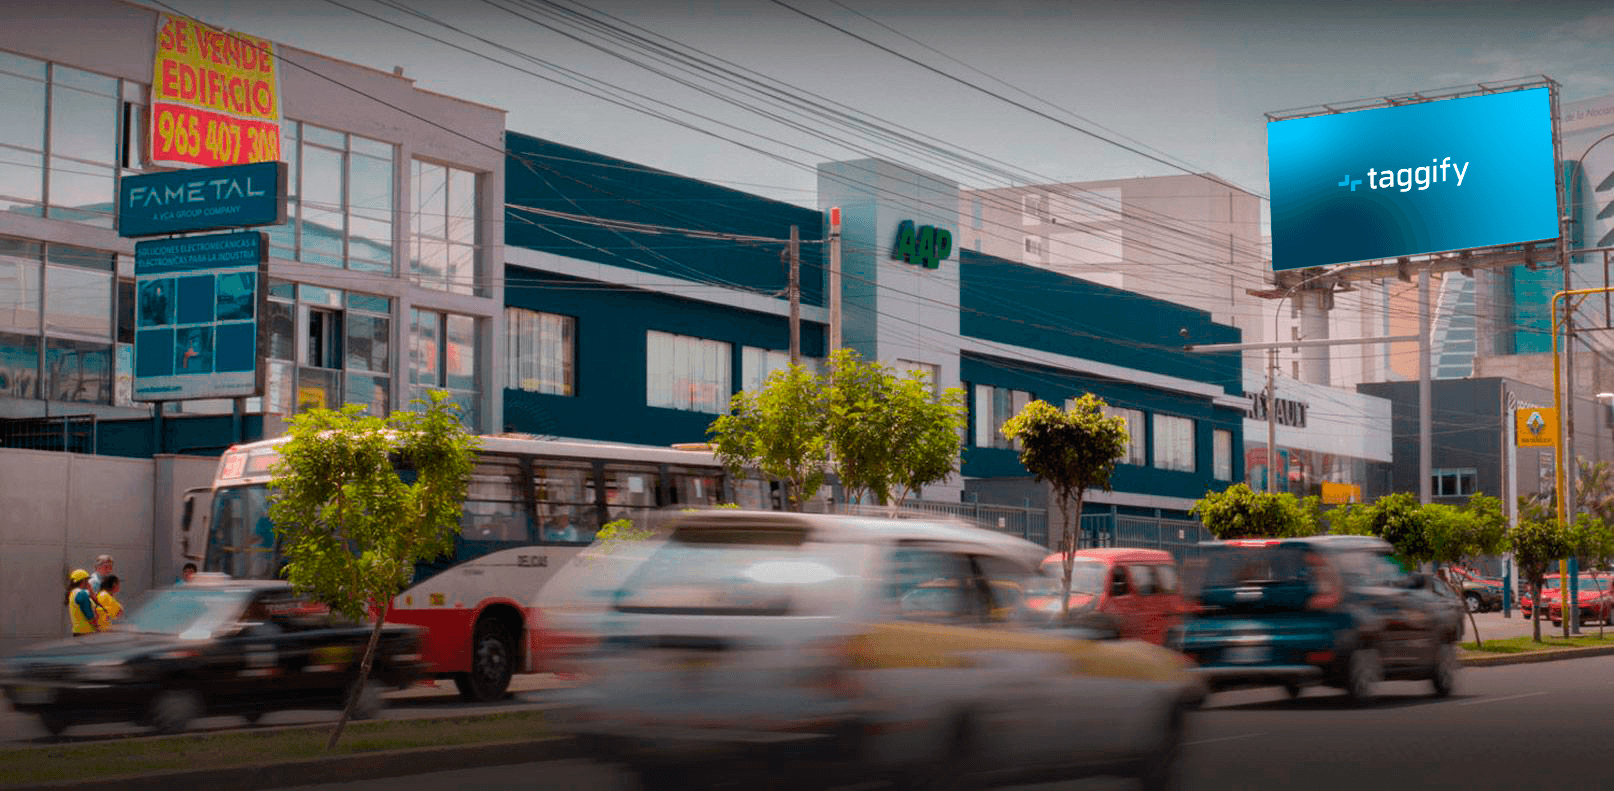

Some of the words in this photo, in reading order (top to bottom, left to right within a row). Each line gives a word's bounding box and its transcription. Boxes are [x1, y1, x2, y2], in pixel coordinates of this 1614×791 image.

[160, 18, 189, 54] SE
[195, 26, 272, 73] VENDE
[162, 58, 273, 116] EDIFICIO
[158, 111, 200, 157] 965
[205, 119, 241, 164] 407
[129, 177, 266, 208] FAMETAL
[1367, 157, 1469, 192] taggify
[176, 208, 202, 219] GROUP
[203, 205, 241, 217] COMPANY
